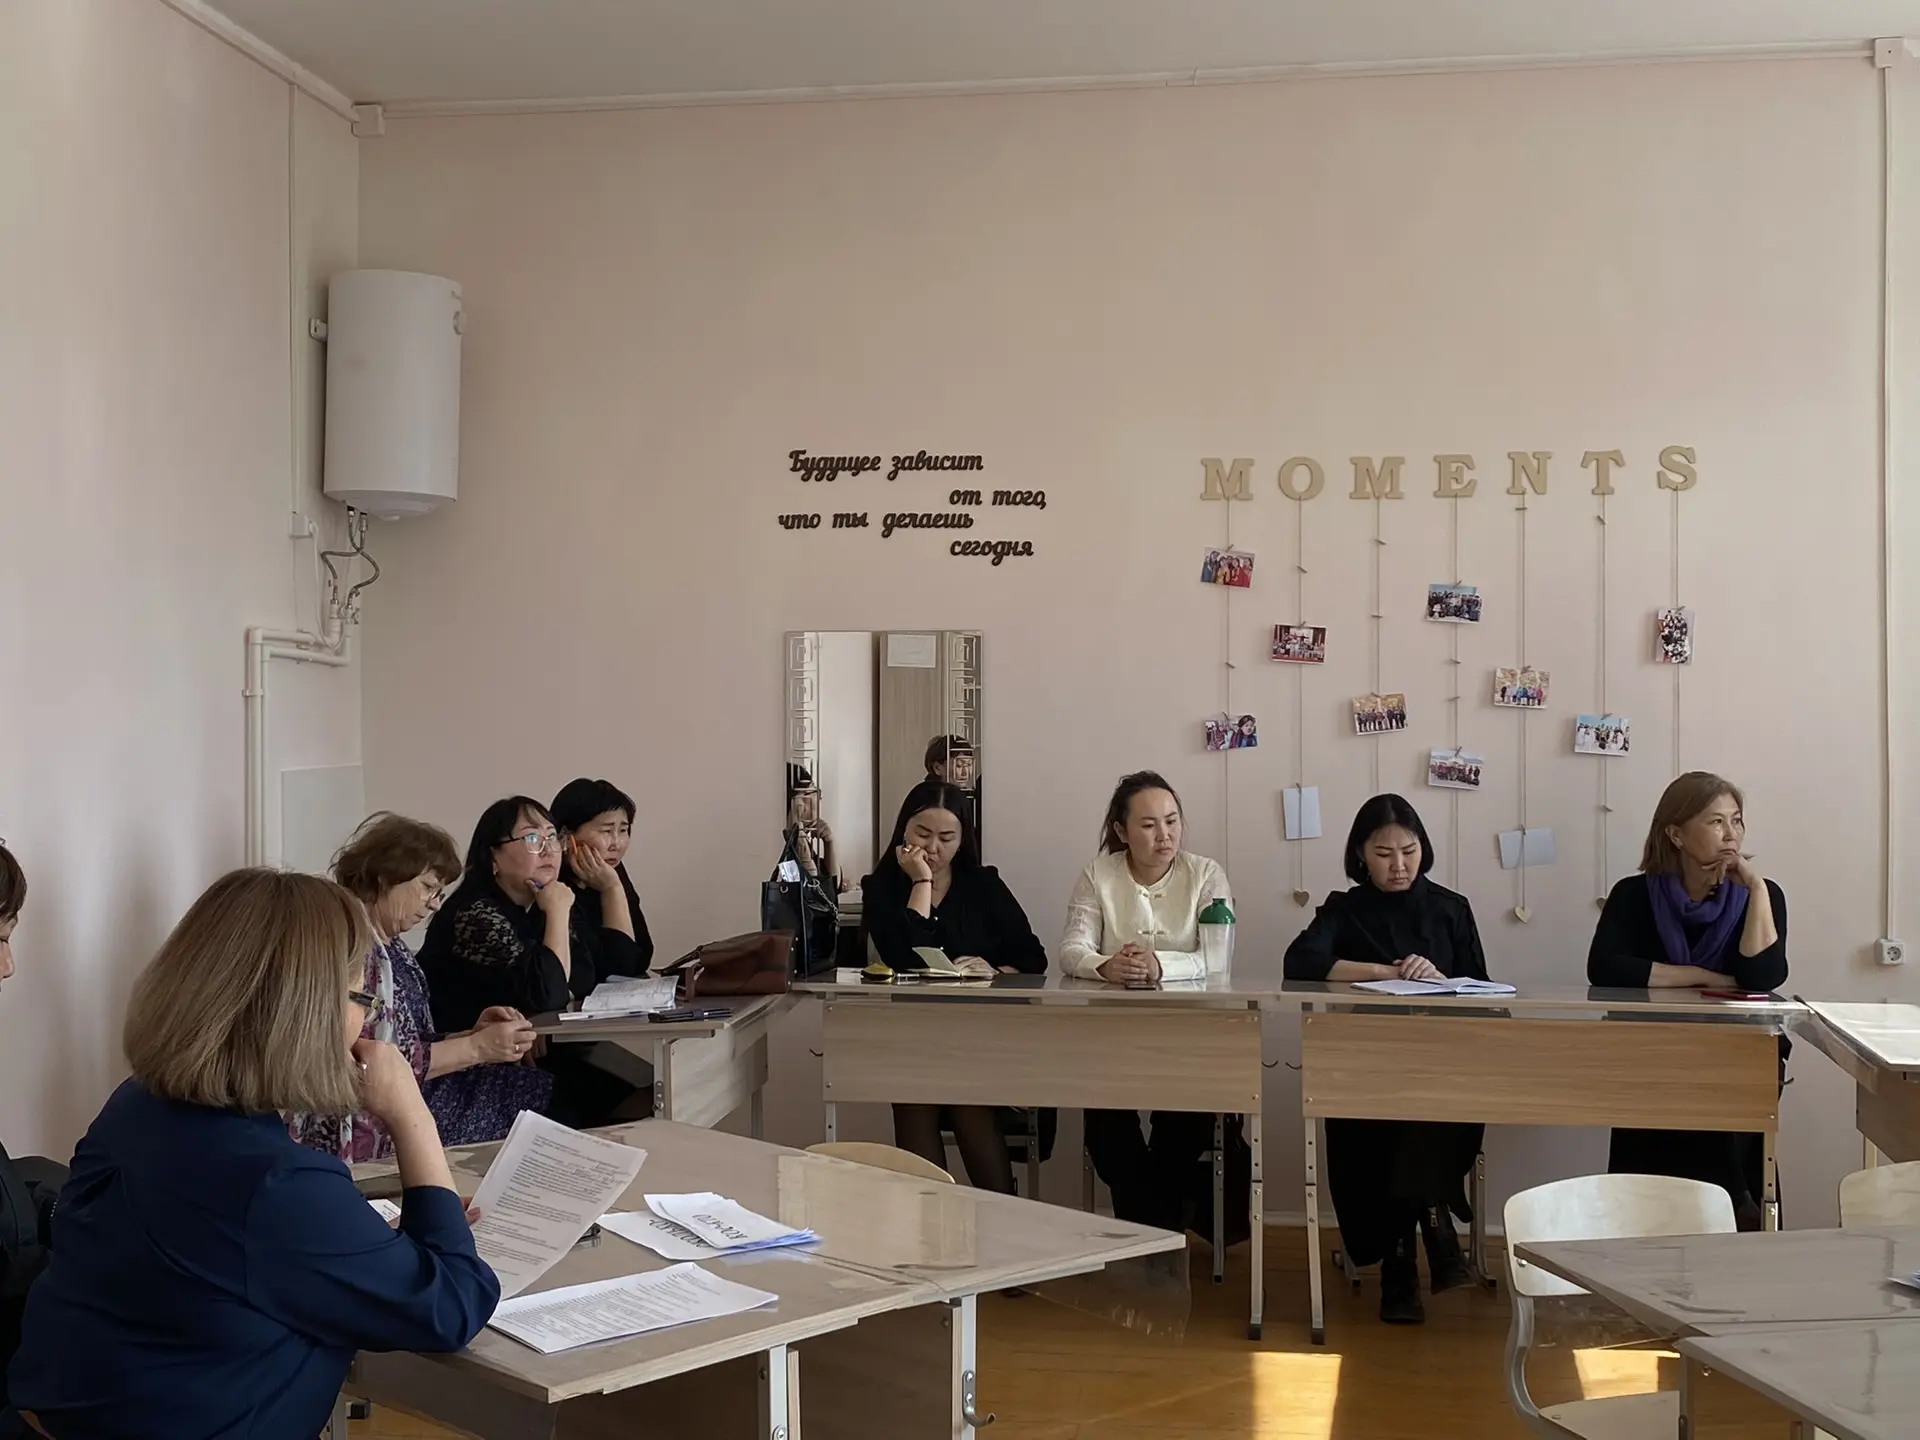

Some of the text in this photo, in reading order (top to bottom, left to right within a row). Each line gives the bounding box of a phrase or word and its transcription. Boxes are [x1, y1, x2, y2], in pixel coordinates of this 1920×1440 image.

[788, 449, 984, 482] Будущее зависит
[1200, 445, 1697, 501] MOMENTS
[949, 489, 1047, 511] от того,
[778, 511, 975, 539] что ты делаешь
[949, 539, 1035, 567] сегодня
